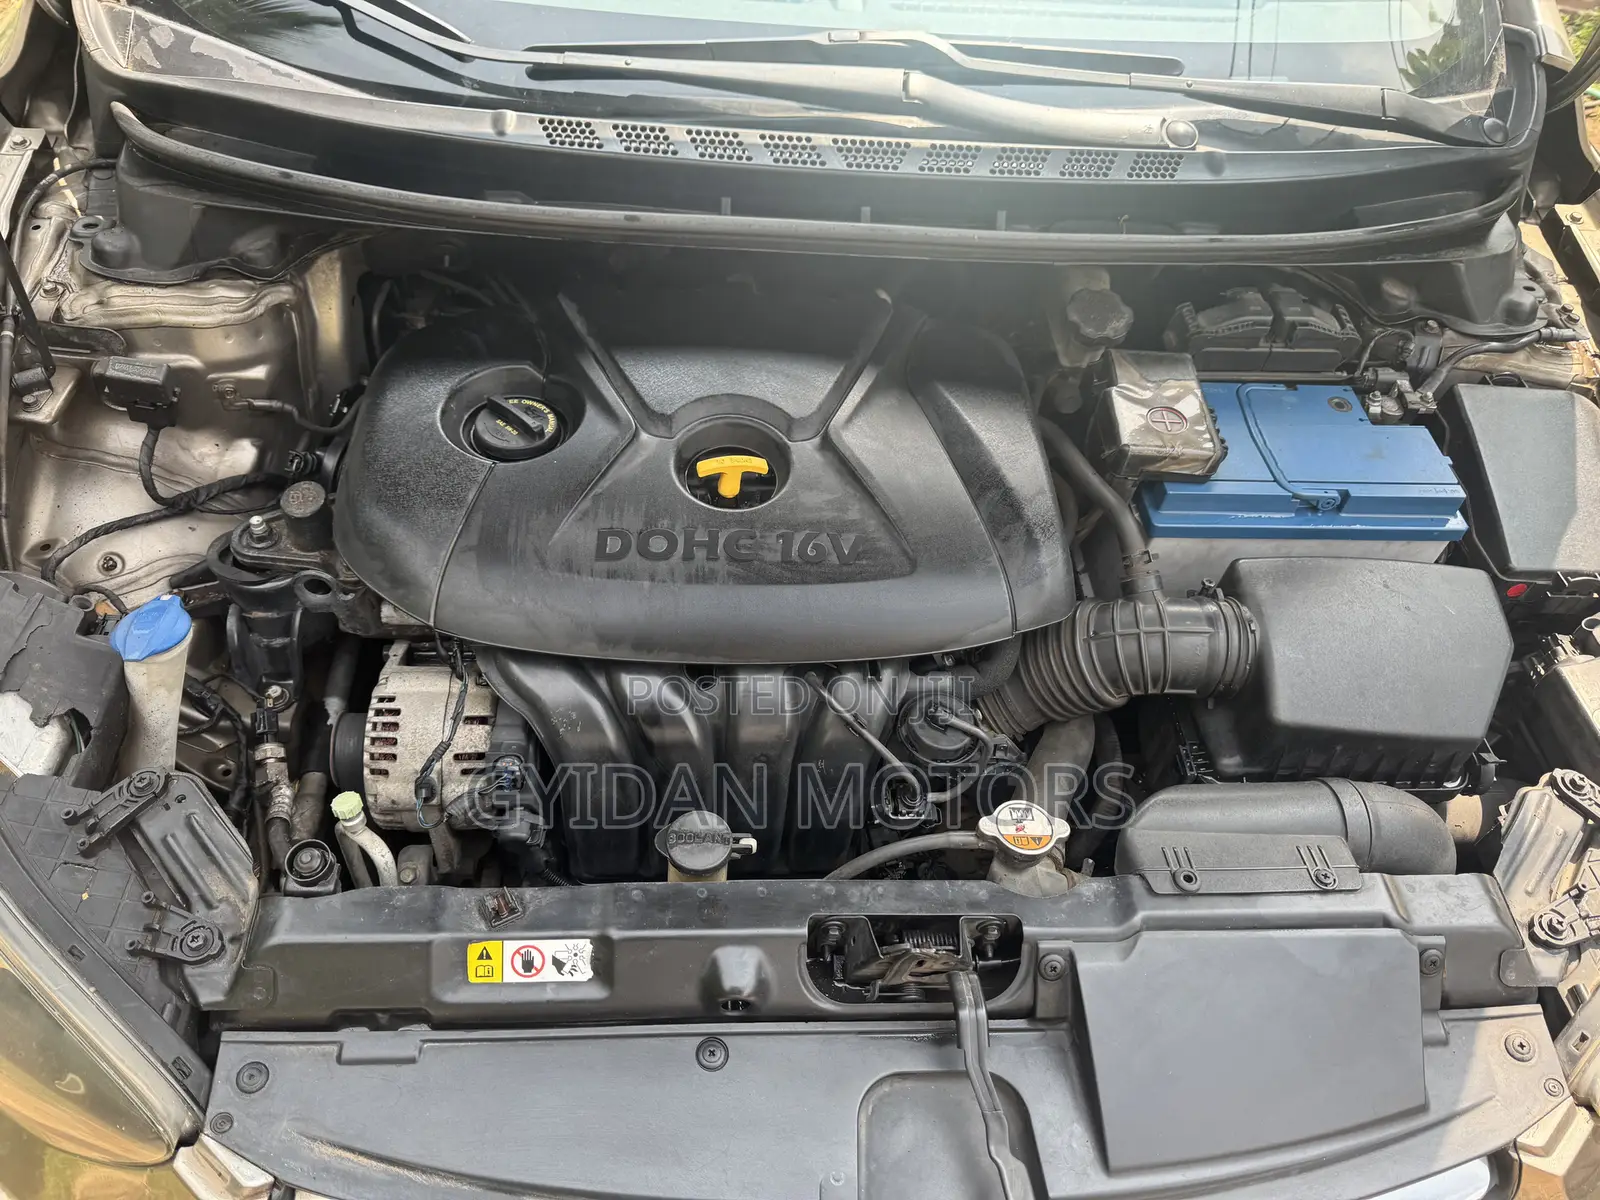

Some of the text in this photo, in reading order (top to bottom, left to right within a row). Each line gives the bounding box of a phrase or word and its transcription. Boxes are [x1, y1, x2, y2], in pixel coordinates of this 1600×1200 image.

[521, 399, 550, 414] OWNER'S
[595, 528, 864, 564] DOHC 16V
